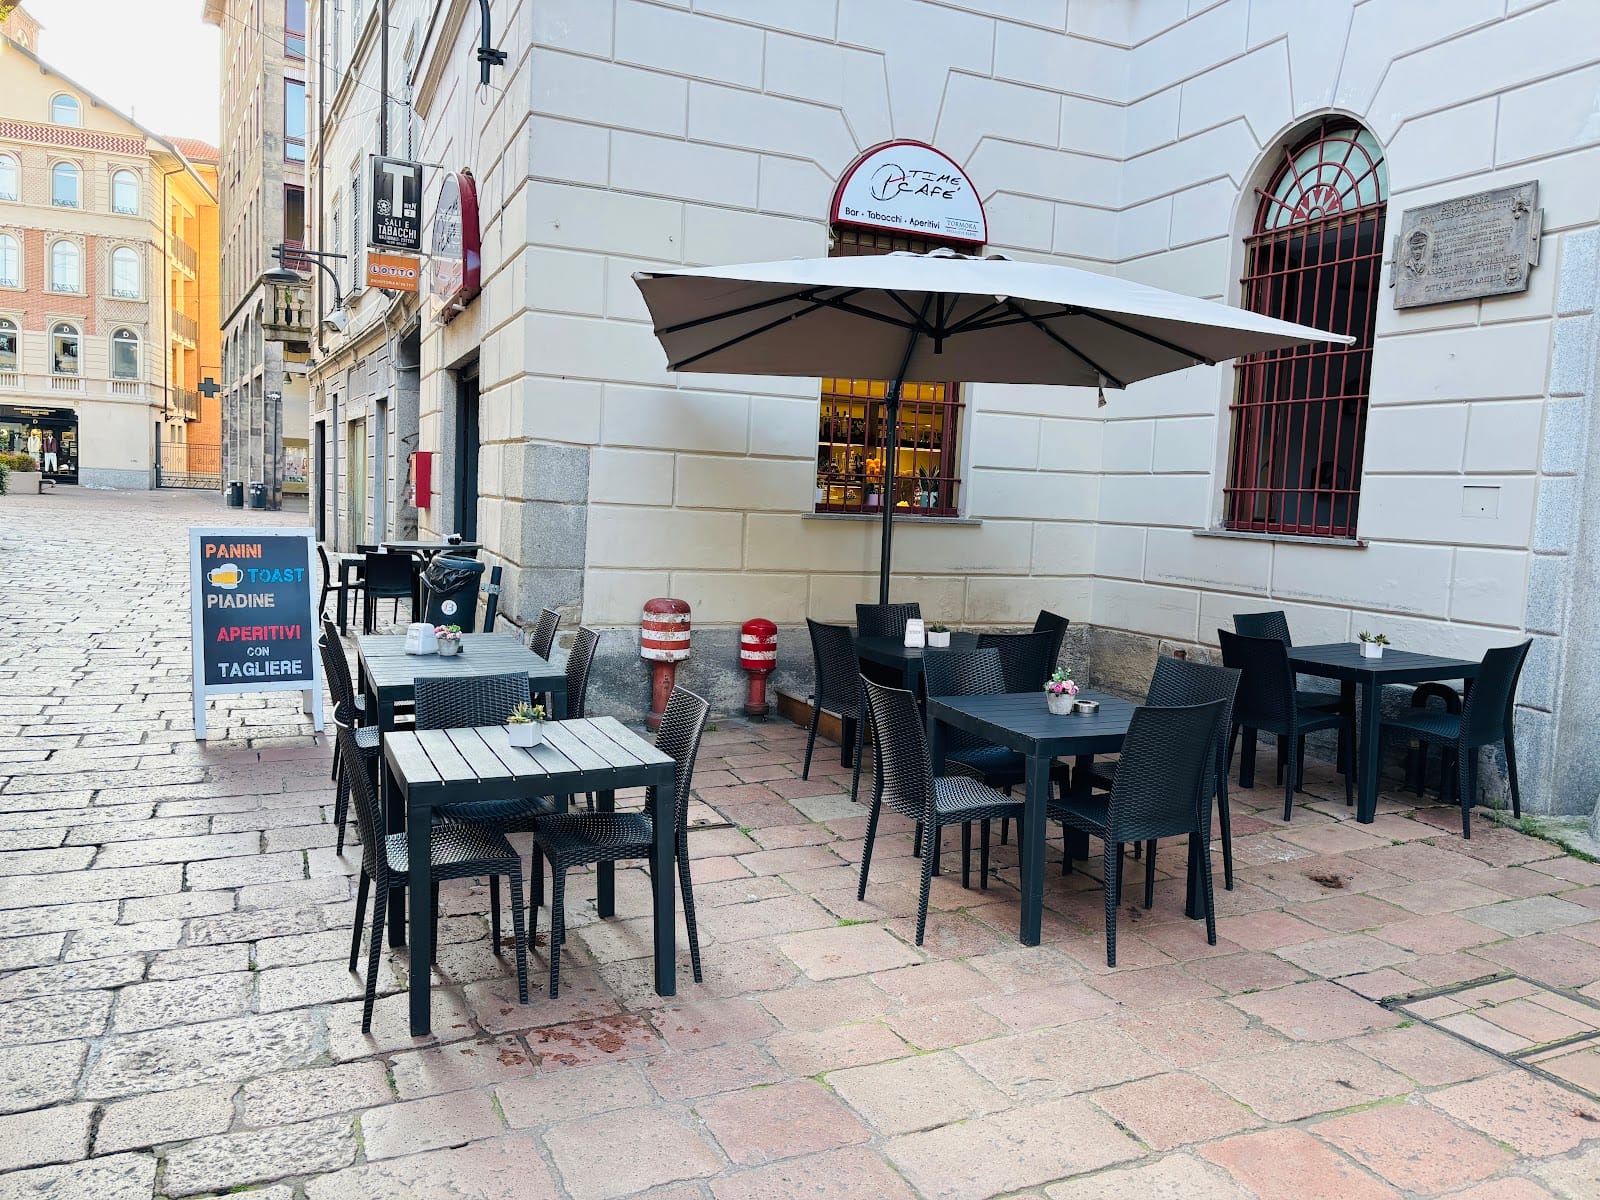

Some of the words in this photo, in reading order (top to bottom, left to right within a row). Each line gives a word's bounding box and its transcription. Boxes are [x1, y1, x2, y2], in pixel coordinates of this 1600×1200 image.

[909, 170, 961, 185] TIME
[383, 162, 415, 218] T
[384, 217, 401, 228] SALI
[404, 220, 410, 229] E
[845, 207, 859, 217] Bar
[867, 210, 902, 223] Tabacchi
[909, 217, 940, 229] Aperitivi
[378, 223, 417, 240] TABACCHI
[371, 264, 415, 278] LOTTO
[205, 543, 262, 559] PANINI
[248, 568, 304, 583] TOAST
[207, 593, 275, 609] PIADINE
[217, 624, 301, 642] APERITIVI
[247, 646, 270, 657] CON
[218, 660, 303, 678] TAGLIERE
